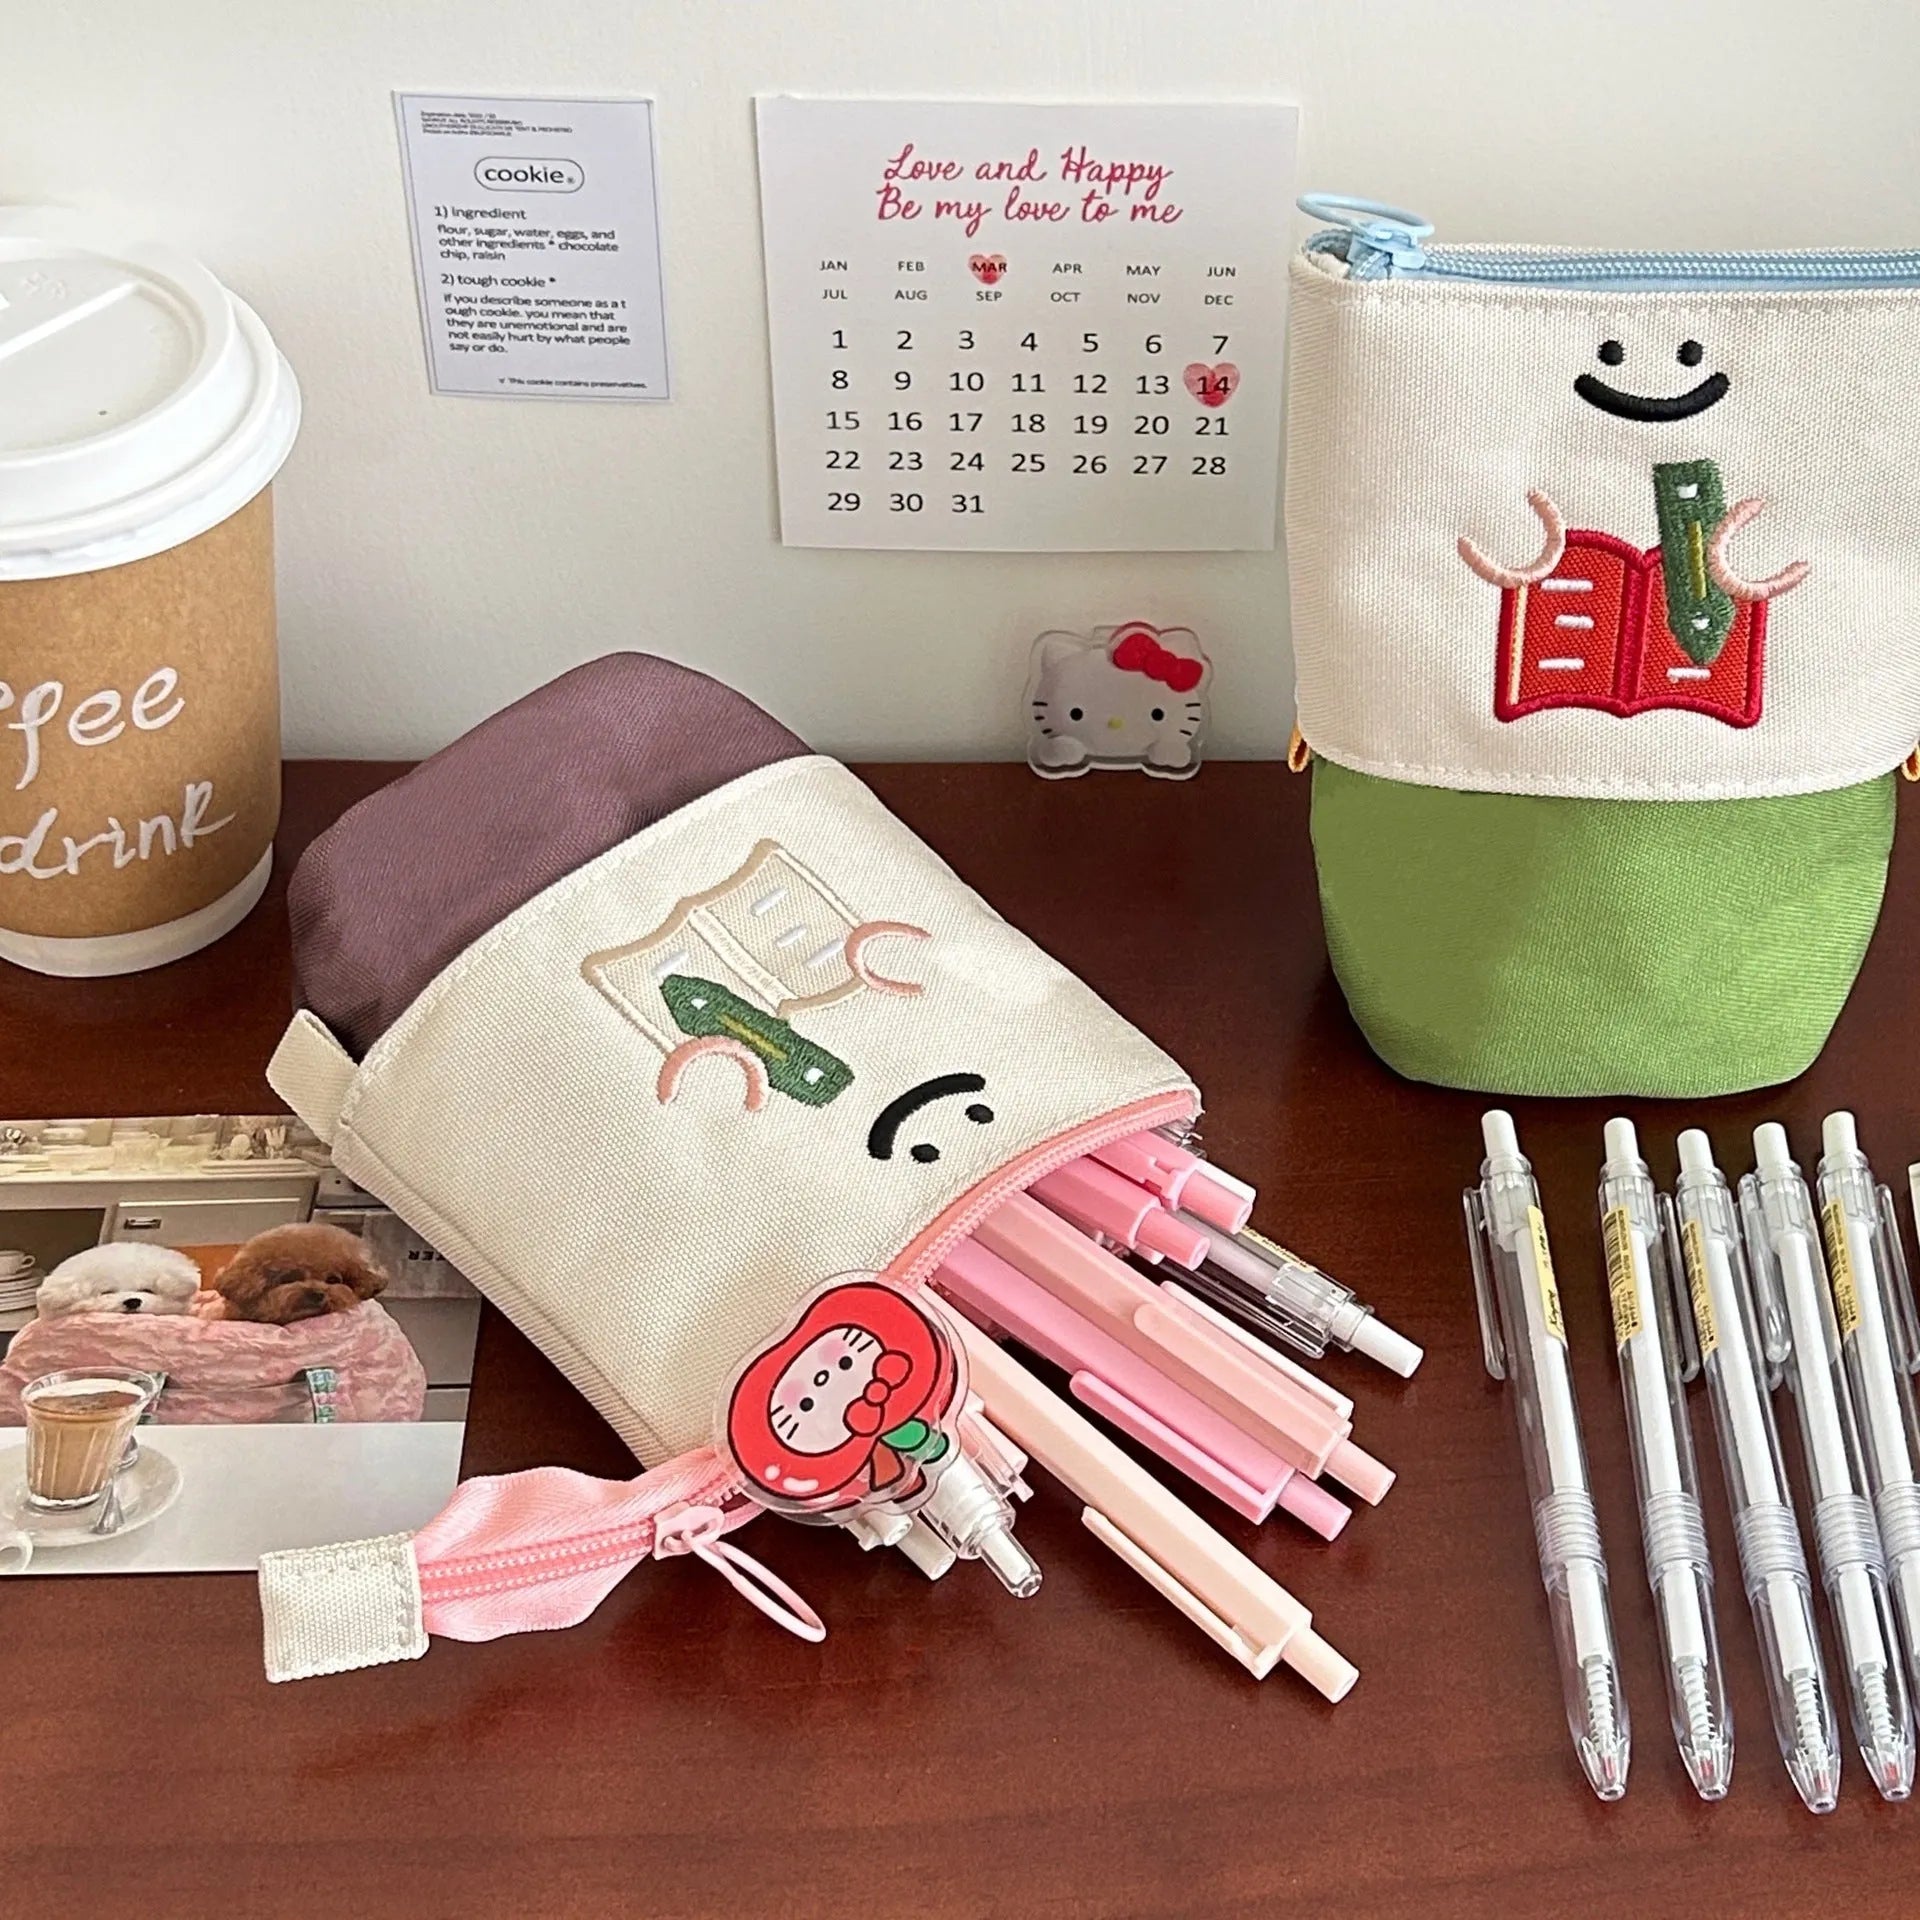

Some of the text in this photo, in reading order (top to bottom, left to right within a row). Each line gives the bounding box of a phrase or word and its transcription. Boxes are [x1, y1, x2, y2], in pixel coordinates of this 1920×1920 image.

[883, 143, 1174, 201] Love and Happy
[434, 206, 449, 219] 1)
[877, 182, 1183, 237] Be my love to me
[821, 261, 1235, 276] JAN FEB MAR APR MAY JUN
[441, 274, 455, 287] 2)
[457, 274, 499, 288] tough
[501, 276, 545, 288] cookie
[823, 290, 1233, 305] JUL AUG SEP OCT NOV DEC
[446, 307, 476, 320] ough
[525, 310, 549, 322] you
[552, 311, 586, 320] mean
[589, 310, 615, 320] that
[447, 319, 627, 333] they are unemotional and are
[450, 343, 508, 354] say or do.
[833, 330, 1228, 354] 1 2 3 4 5 6 7
[832, 370, 1231, 396] 8 9 10 11 12 13 14
[827, 412, 1228, 435] 15 16 17 18 19 20 21
[827, 451, 1225, 475] 22 23 24 25 26 27 28
[828, 493, 984, 513] 29 30 31
[0, 781, 236, 880] drink
